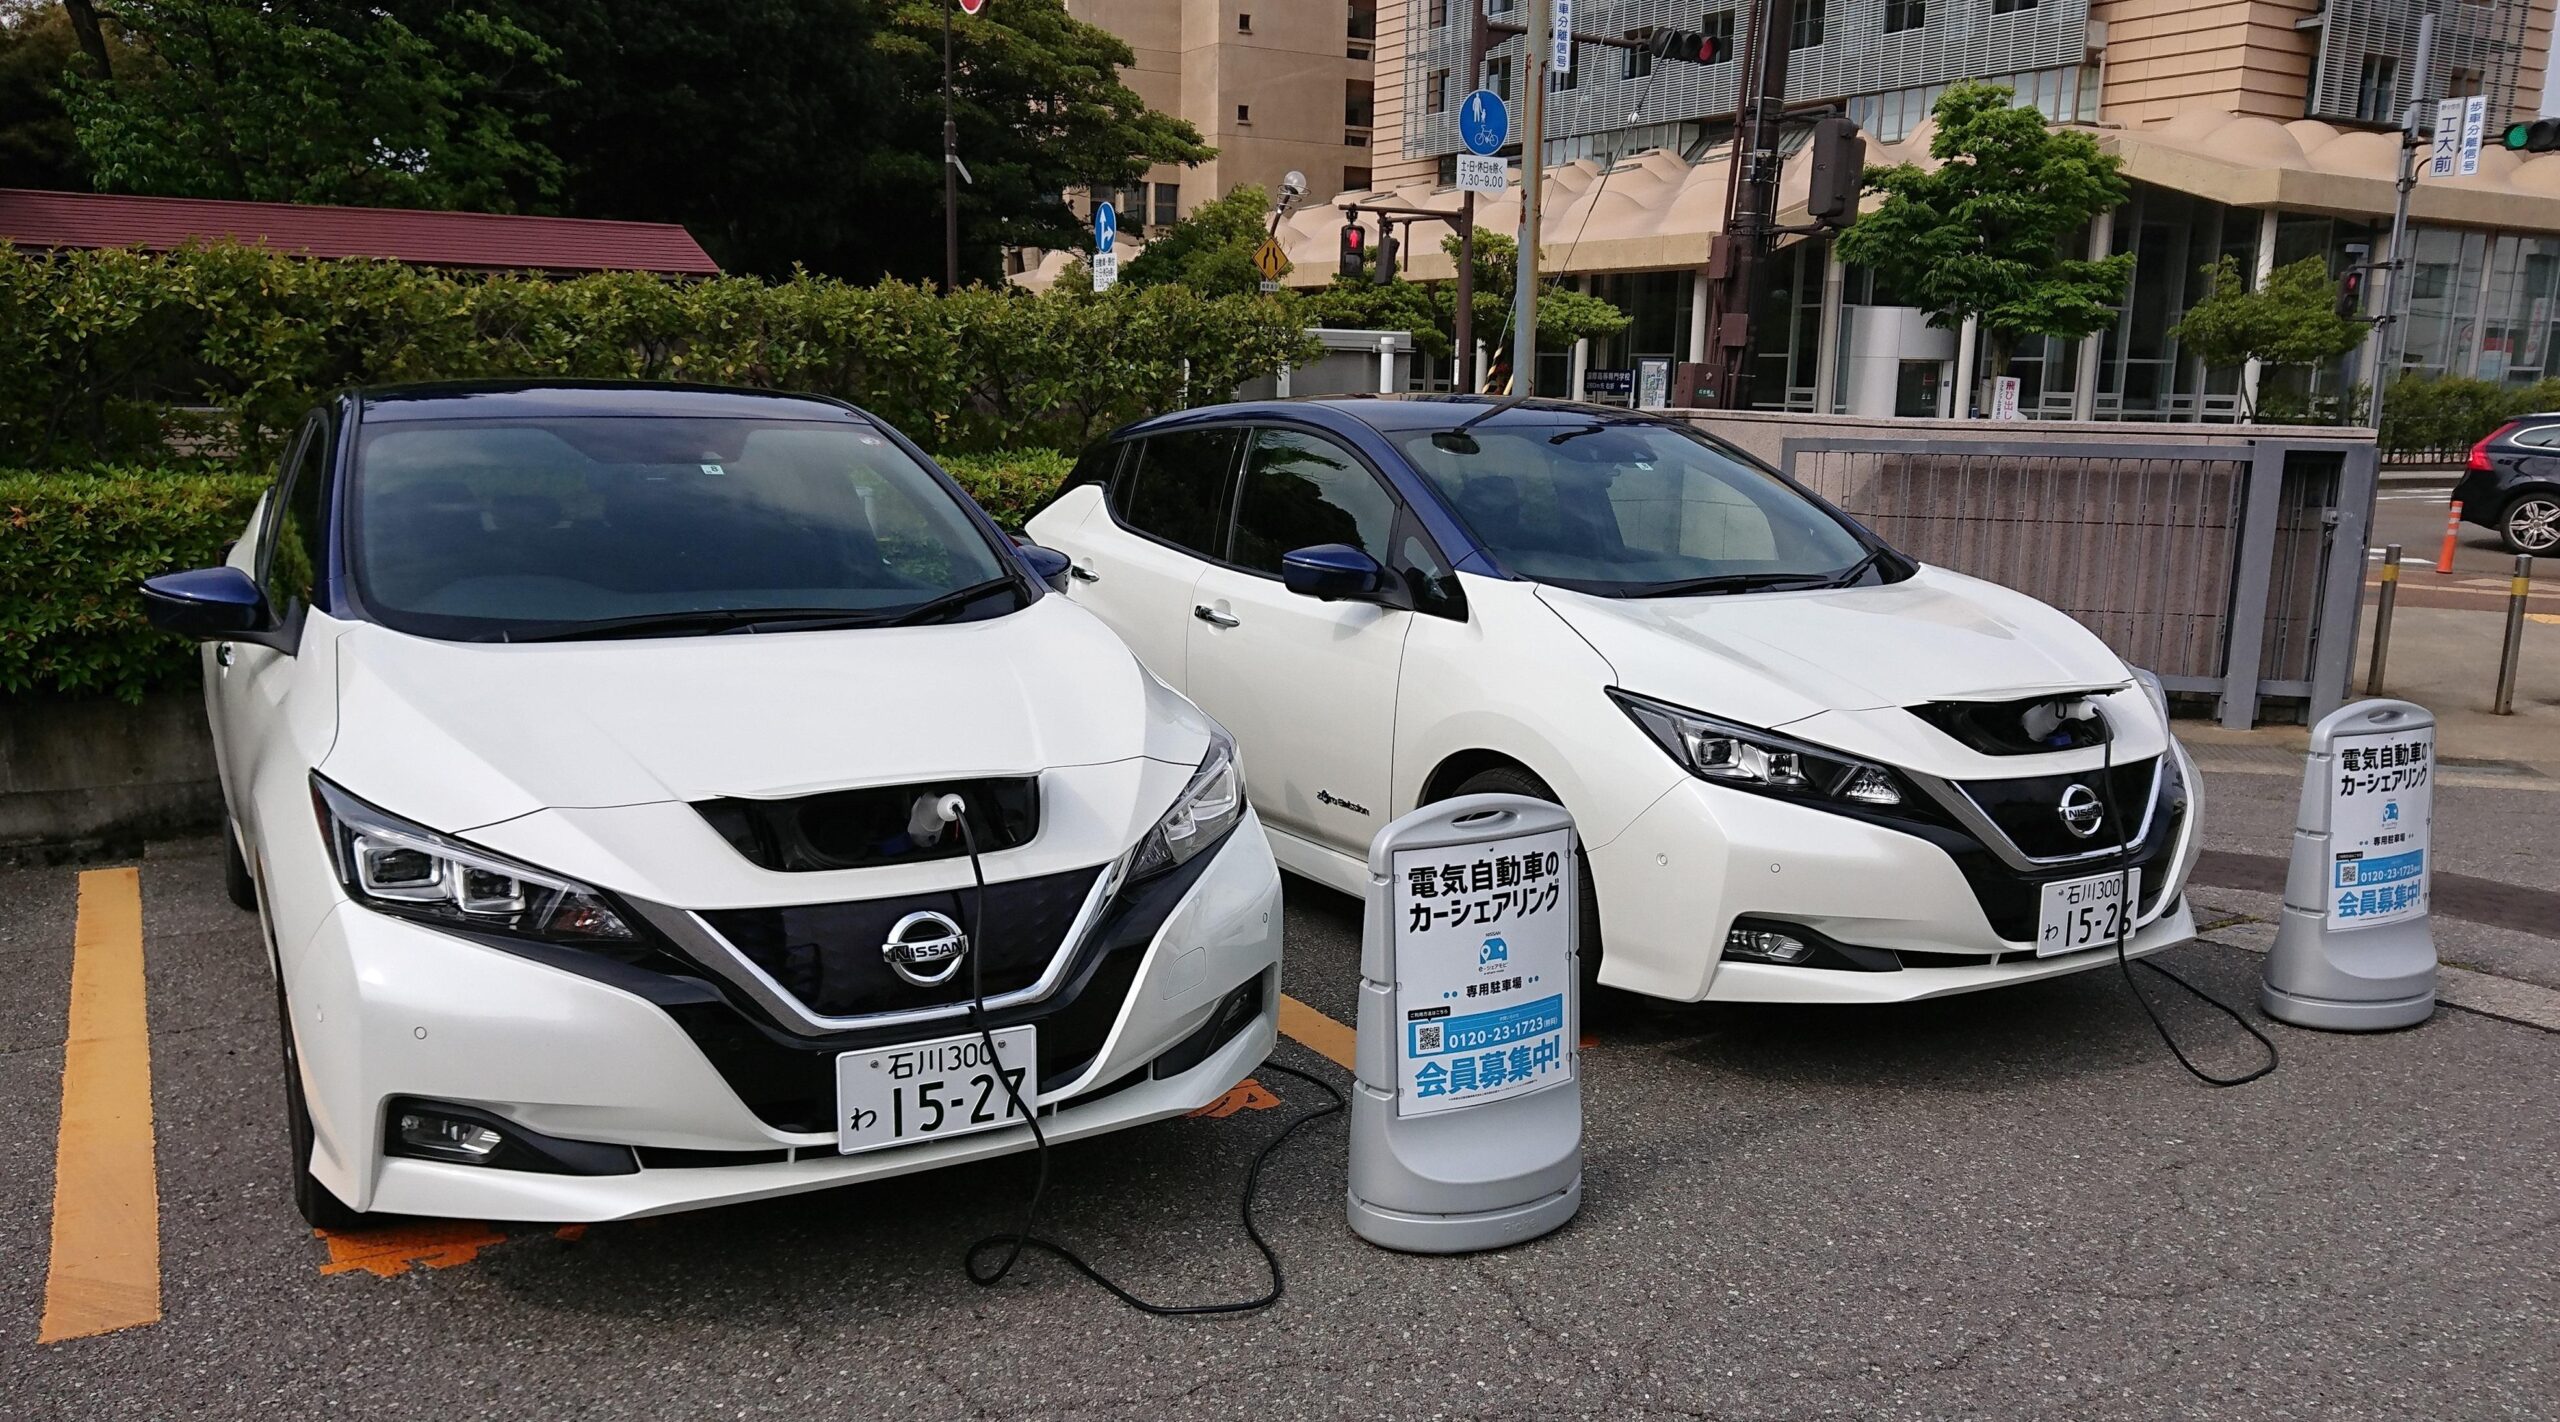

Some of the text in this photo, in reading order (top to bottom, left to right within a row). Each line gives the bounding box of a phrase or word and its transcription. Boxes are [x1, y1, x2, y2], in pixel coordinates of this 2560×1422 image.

[1556, 0, 1568, 67] 車分離信号
[2434, 116, 2458, 173] 工大前
[2463, 101, 2483, 171] 歩車分離信号
[2341, 742, 2428, 771] 電気自動車の
[2340, 763, 2428, 797] カーシェアリング
[1408, 851, 1560, 899] 電気自動車の
[2360, 864, 2413, 882] 0120-23-1723
[1409, 878, 1560, 933] カーシェアリング
[2338, 879, 2421, 918] 会員募集中!
[895, 938, 963, 960] NISSAN
[2044, 923, 2059, 941] わ
[1466, 976, 1522, 998] 専用駐車場
[1449, 1016, 1543, 1049] 0120-23-1723
[1415, 1034, 1560, 1098] 会員募集中!
[850, 1107, 877, 1131] わ
